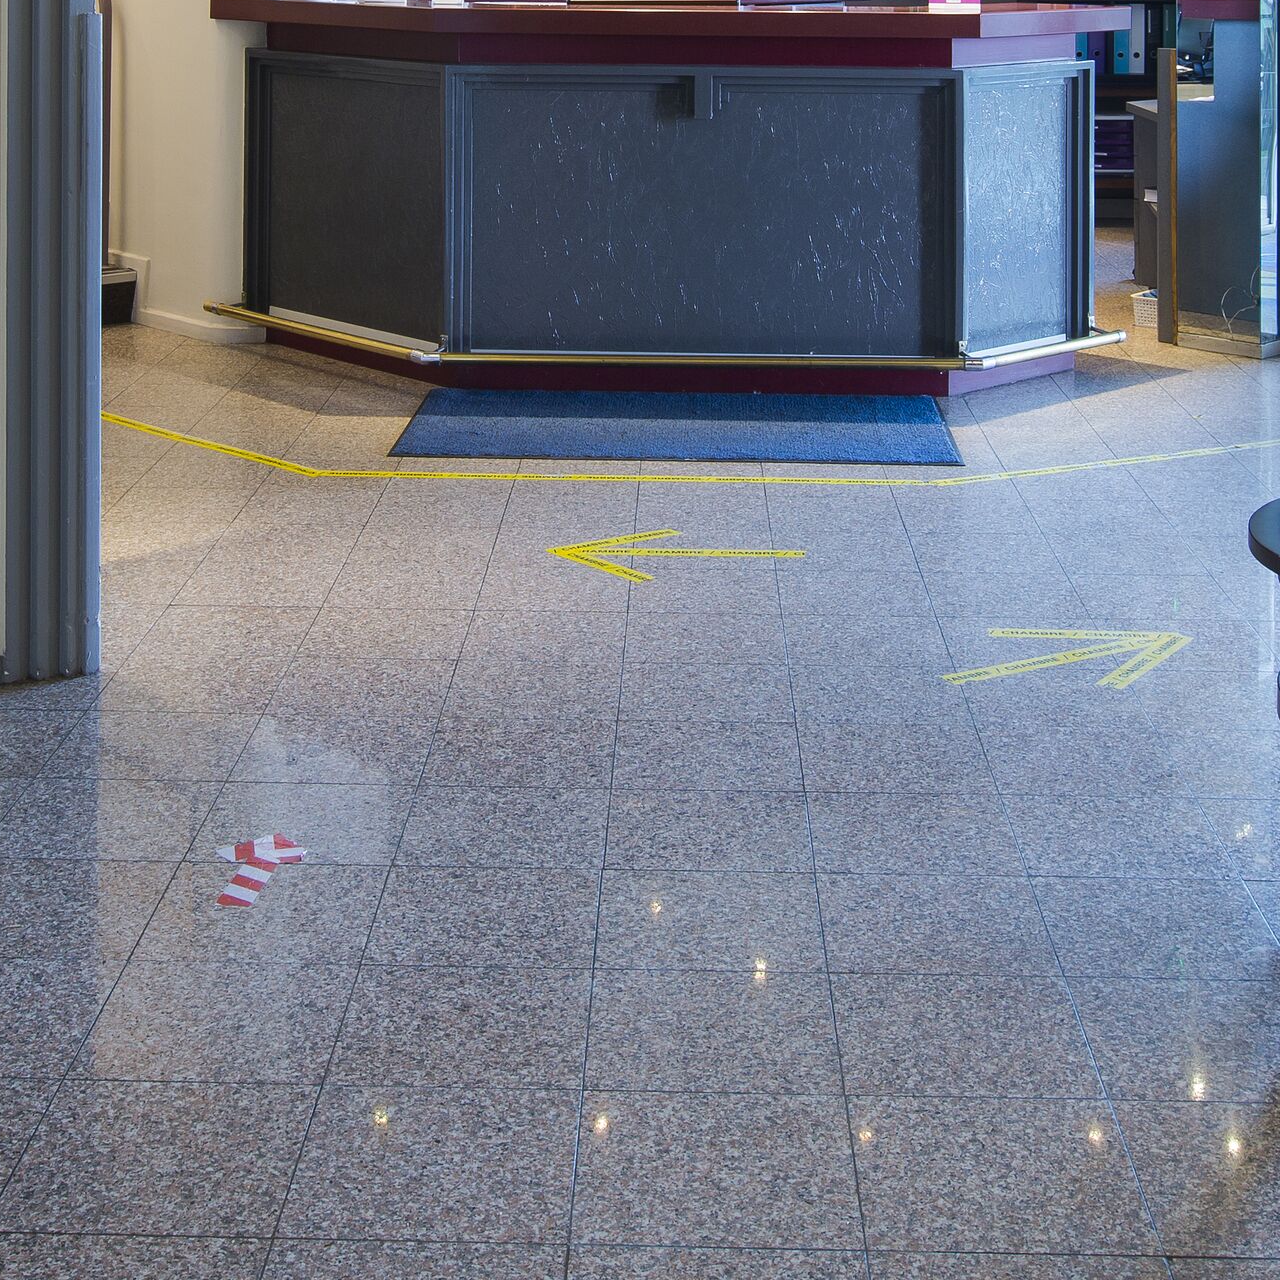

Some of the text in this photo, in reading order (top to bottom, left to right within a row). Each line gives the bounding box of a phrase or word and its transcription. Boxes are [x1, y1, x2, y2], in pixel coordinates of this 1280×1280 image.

[561, 530, 677, 551] CHAMBRE CHAMBRE
[1004, 655, 1062, 671] CHAMBRE
[1072, 644, 1124, 658] CHAMBRE
